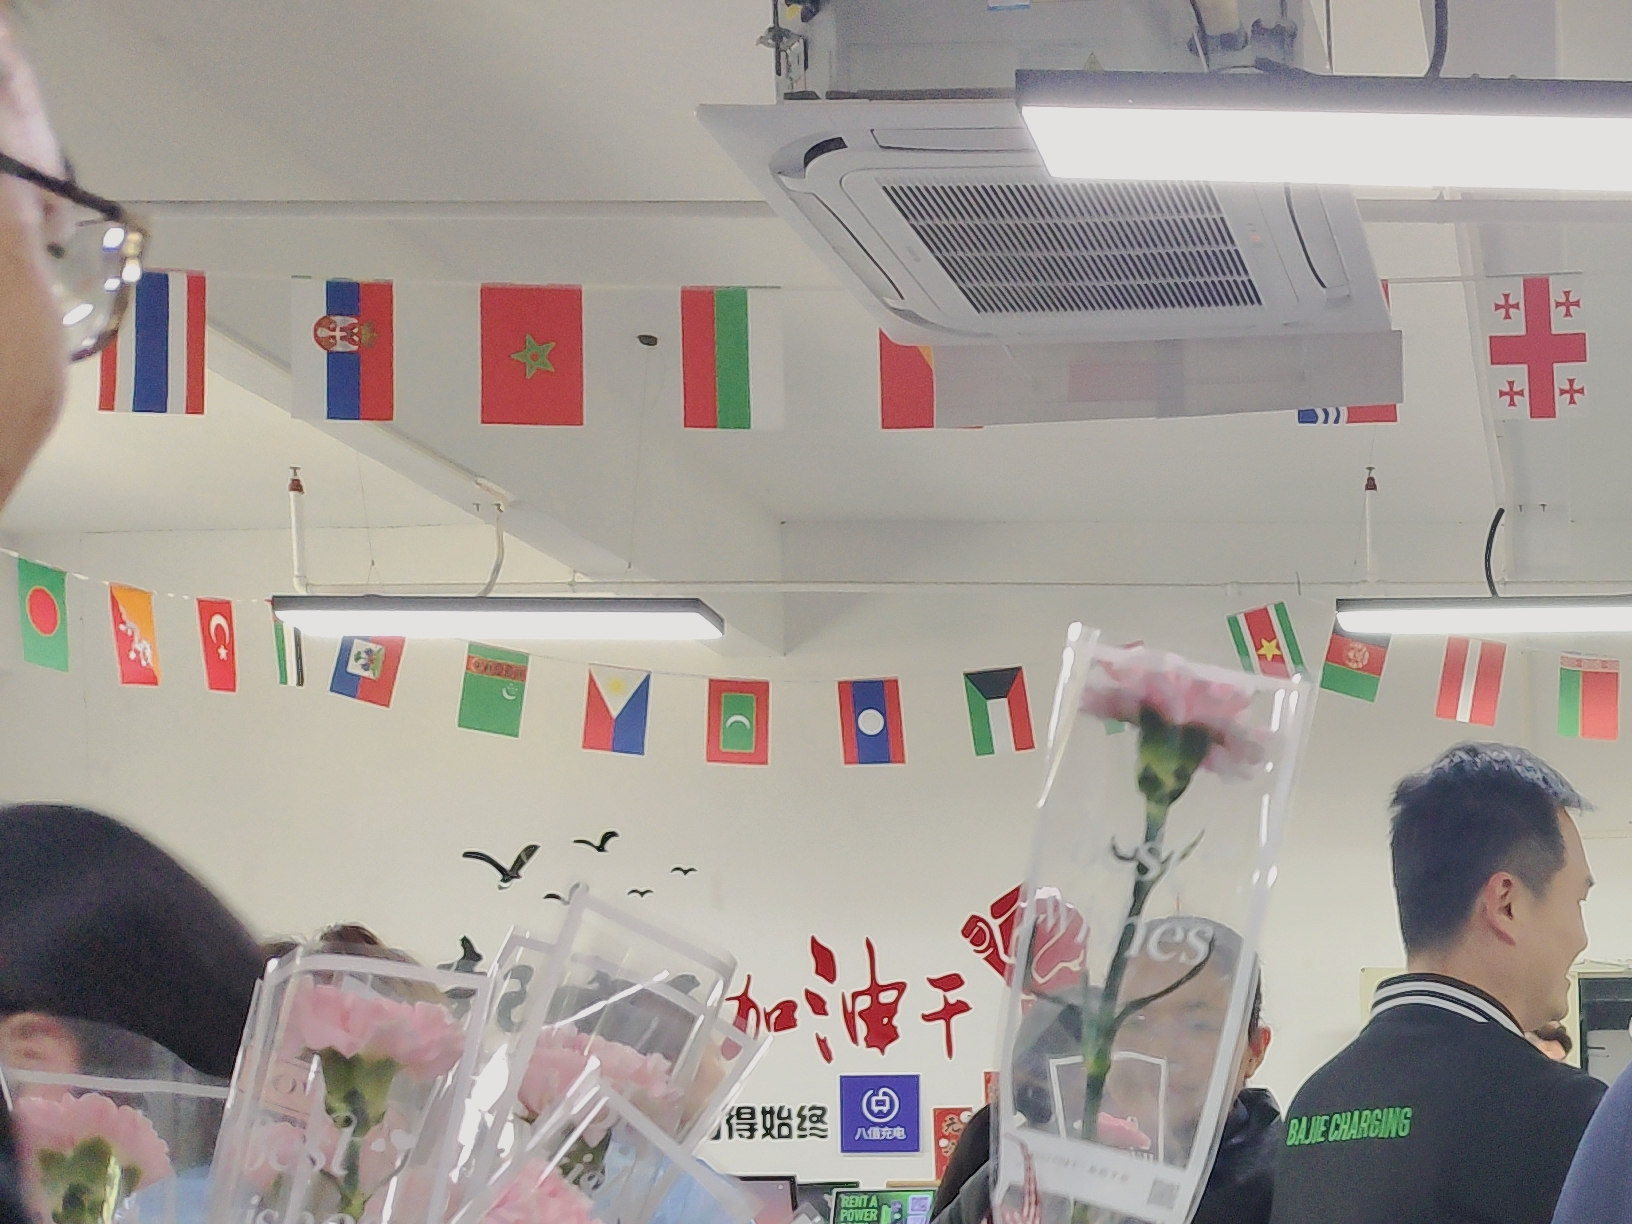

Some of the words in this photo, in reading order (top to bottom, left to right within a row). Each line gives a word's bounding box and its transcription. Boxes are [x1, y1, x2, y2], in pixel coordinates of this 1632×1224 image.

[710, 1105, 829, 1140] 得始终
[1328, 1107, 1413, 1142] CHARGING
[841, 1194, 869, 1208] RENT
[869, 1195, 878, 1208] A
[840, 1208, 878, 1222] POWER
